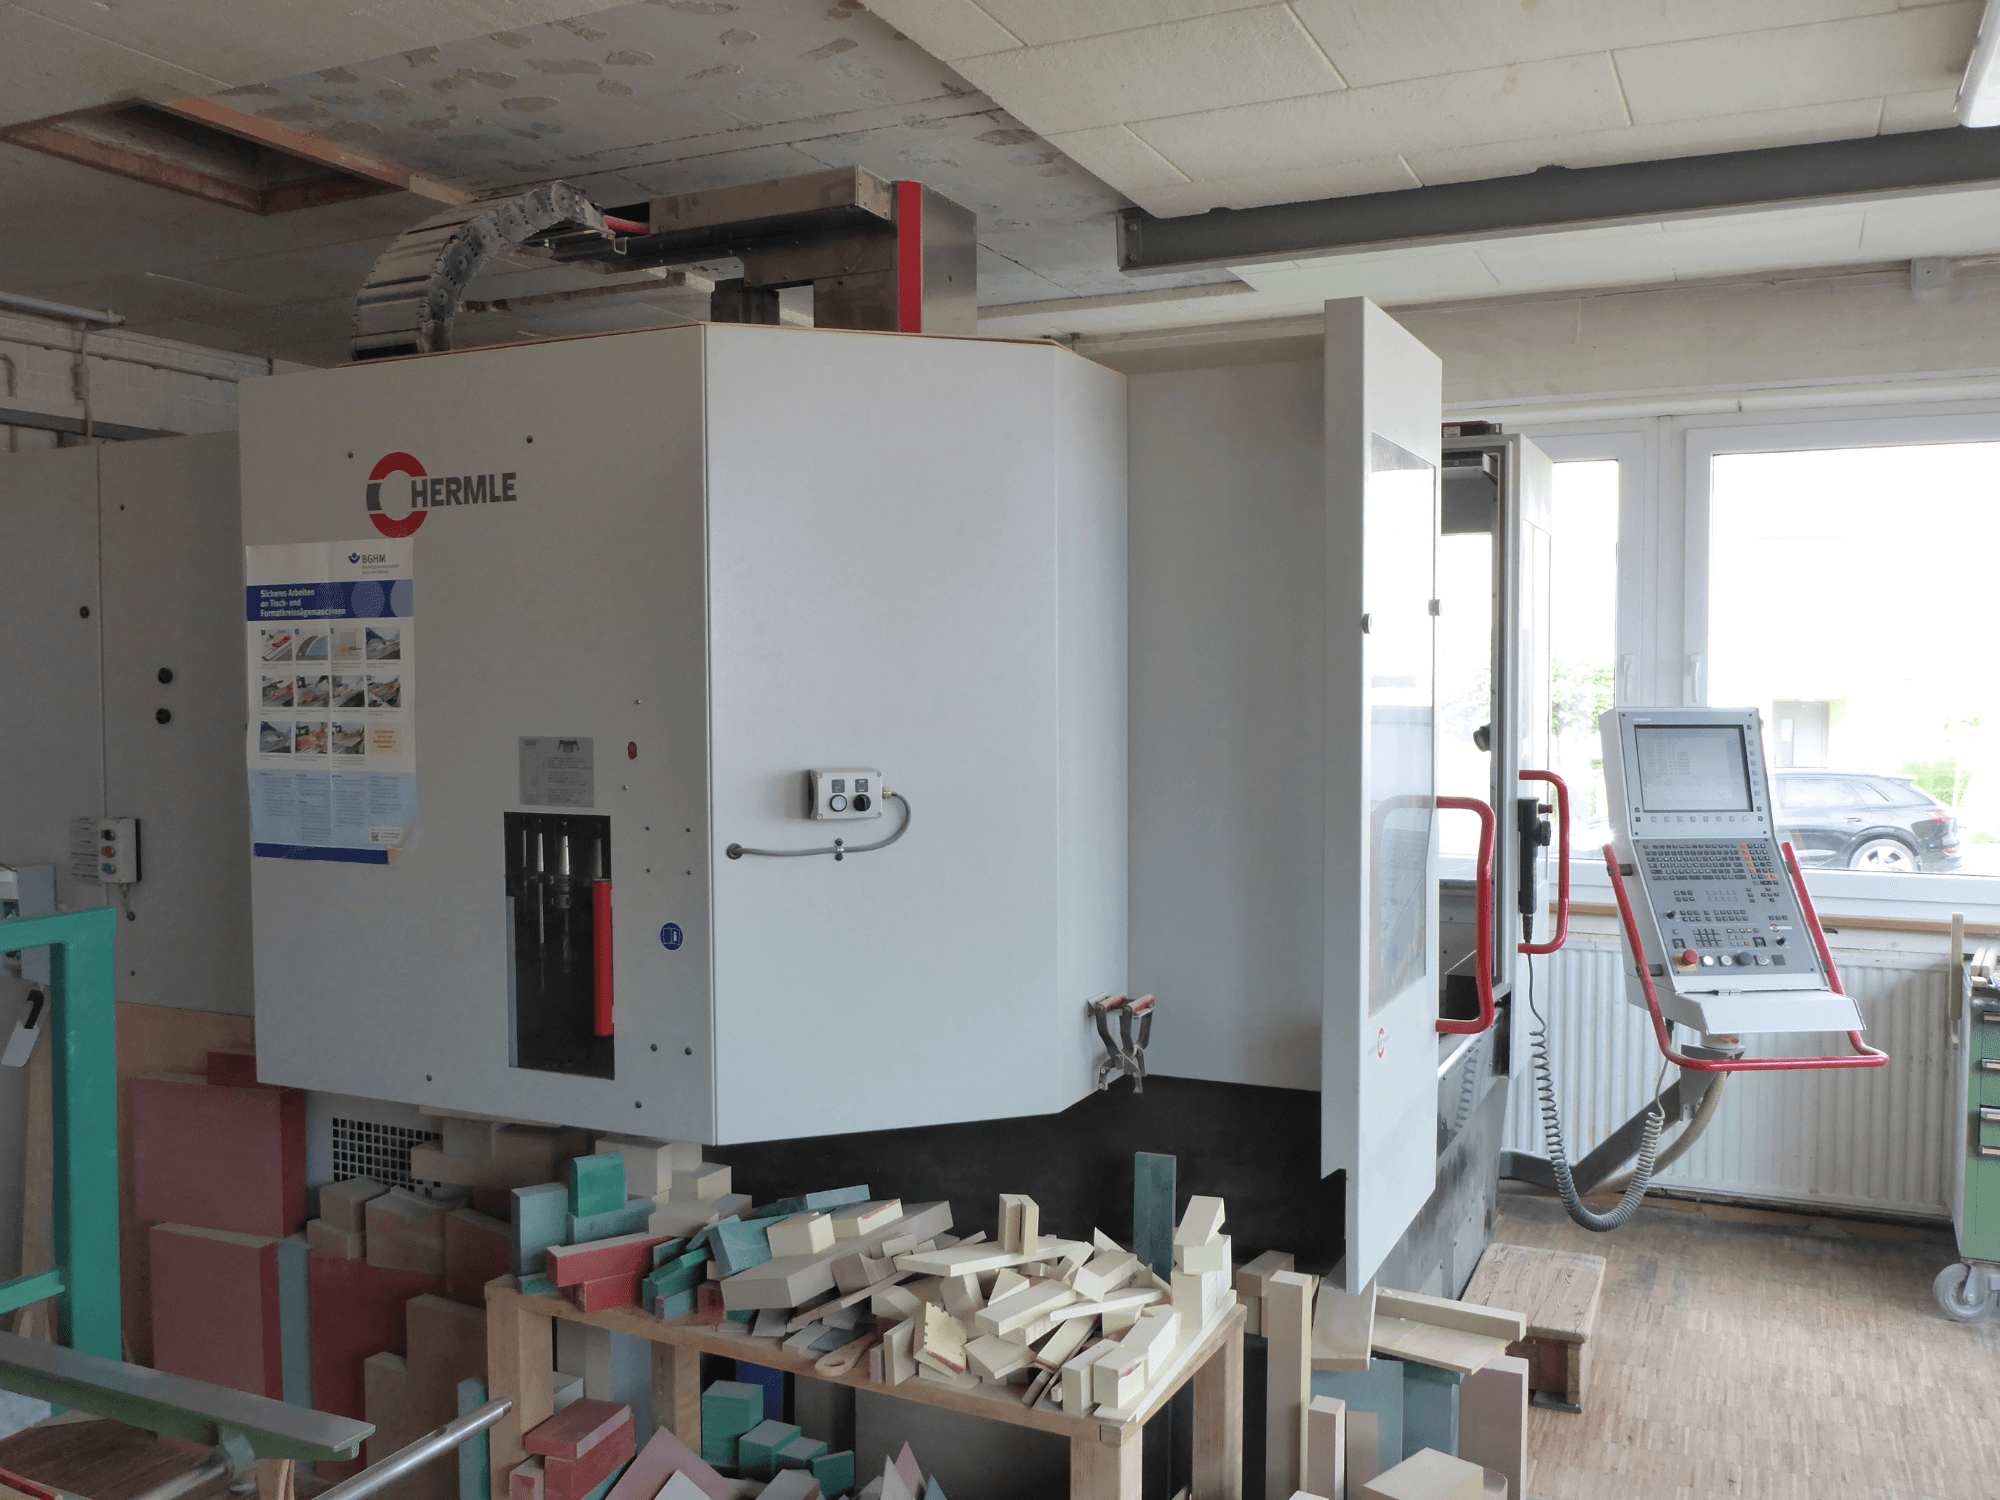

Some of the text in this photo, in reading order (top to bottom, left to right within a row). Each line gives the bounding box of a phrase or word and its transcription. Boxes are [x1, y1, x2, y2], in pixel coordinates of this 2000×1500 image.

[411, 472, 517, 508] HERMLE
[362, 554, 386, 564] BGHM
[260, 588, 315, 598] Sicheres Arbeiten
[260, 598, 302, 608] an Tisch- und
[260, 607, 346, 618] Formatkreissägemaschinen
